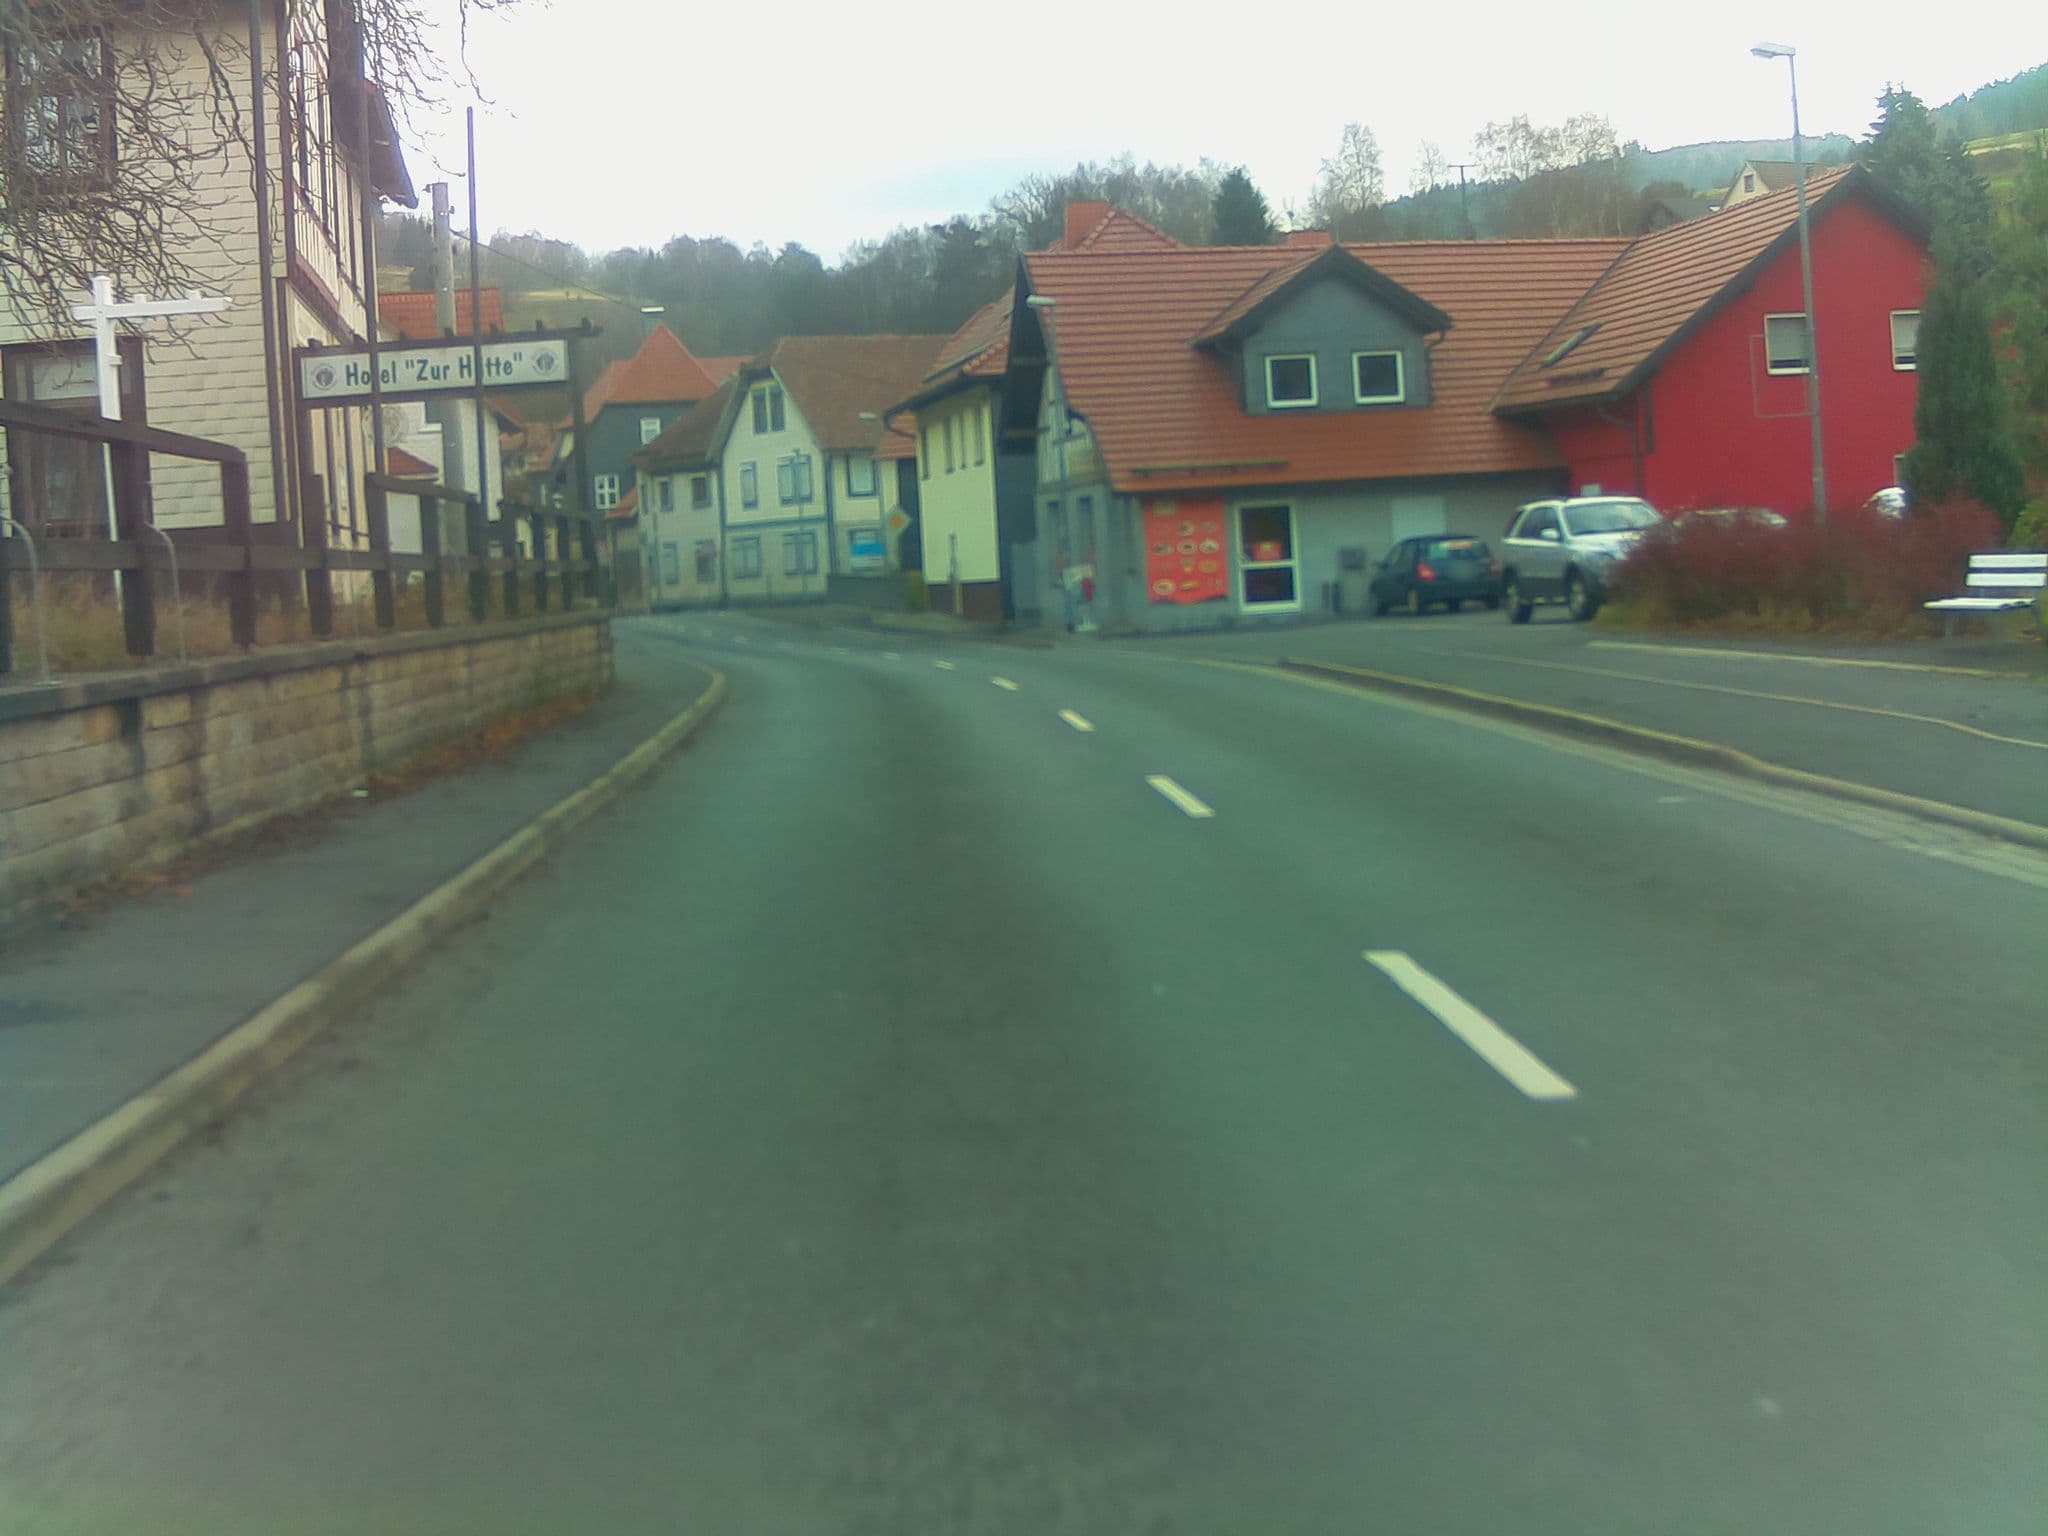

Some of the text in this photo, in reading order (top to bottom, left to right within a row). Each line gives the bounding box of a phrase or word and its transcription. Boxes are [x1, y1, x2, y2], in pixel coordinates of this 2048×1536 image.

[346, 360, 397, 386] Hoel
[405, 358, 450, 382] "Zur
[459, 351, 523, 379] Htte"
